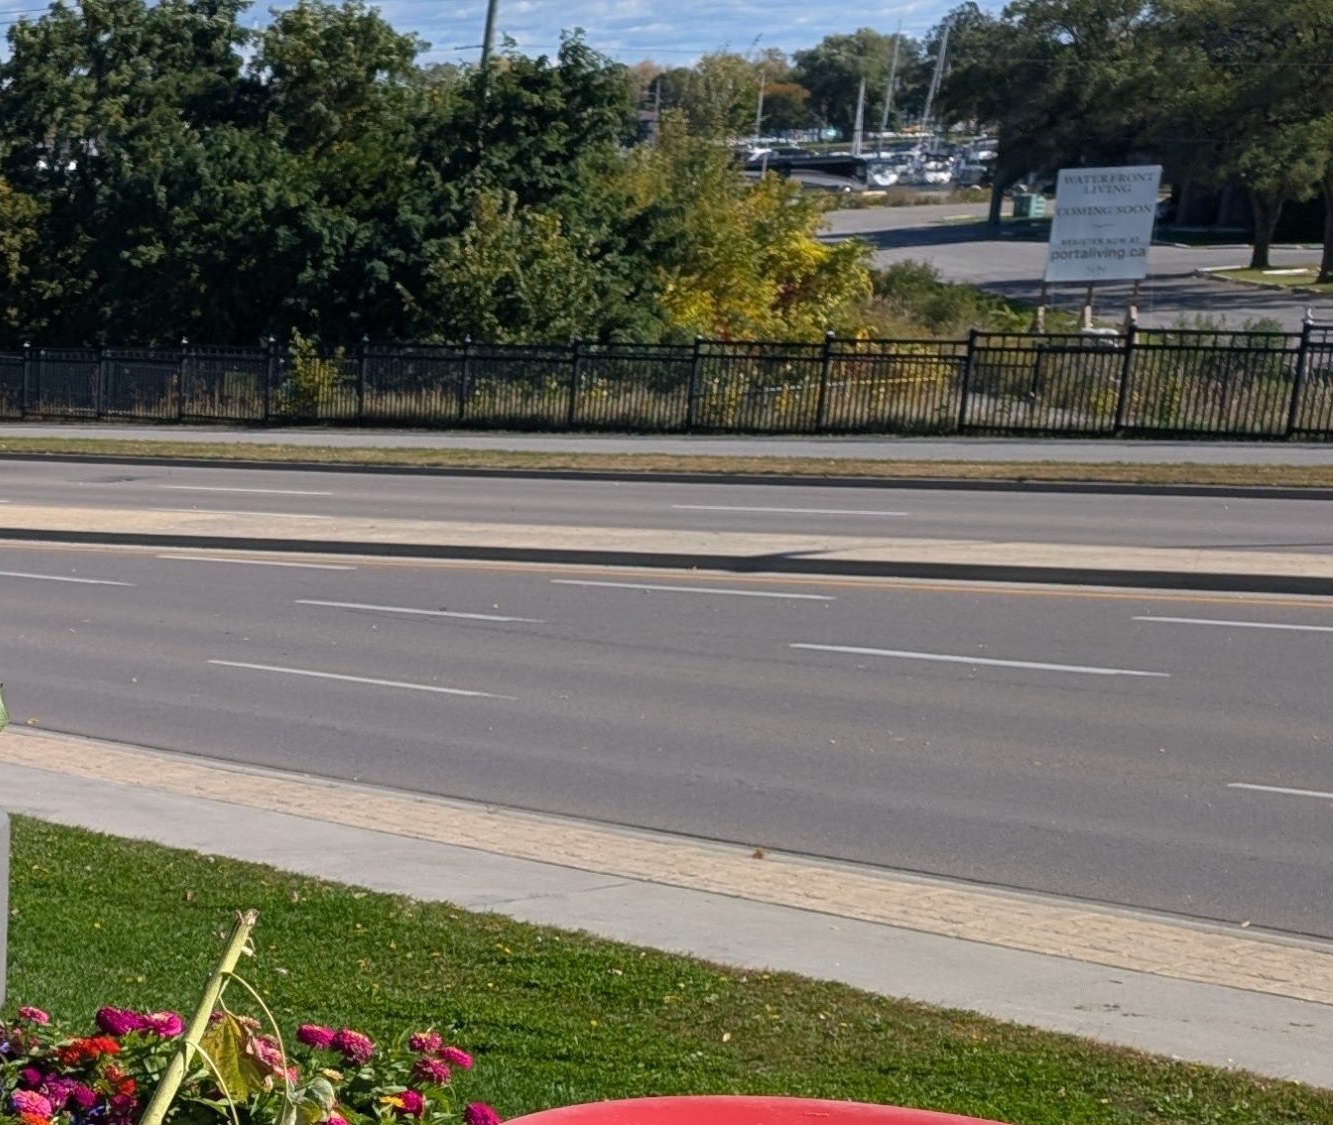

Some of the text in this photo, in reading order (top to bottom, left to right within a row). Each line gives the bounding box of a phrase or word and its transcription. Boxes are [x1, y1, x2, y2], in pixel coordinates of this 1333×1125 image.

[1064, 173, 1154, 184] WATERFRONT
[1084, 185, 1131, 194] LIVING
[1057, 205, 1152, 216] COMING SOON
